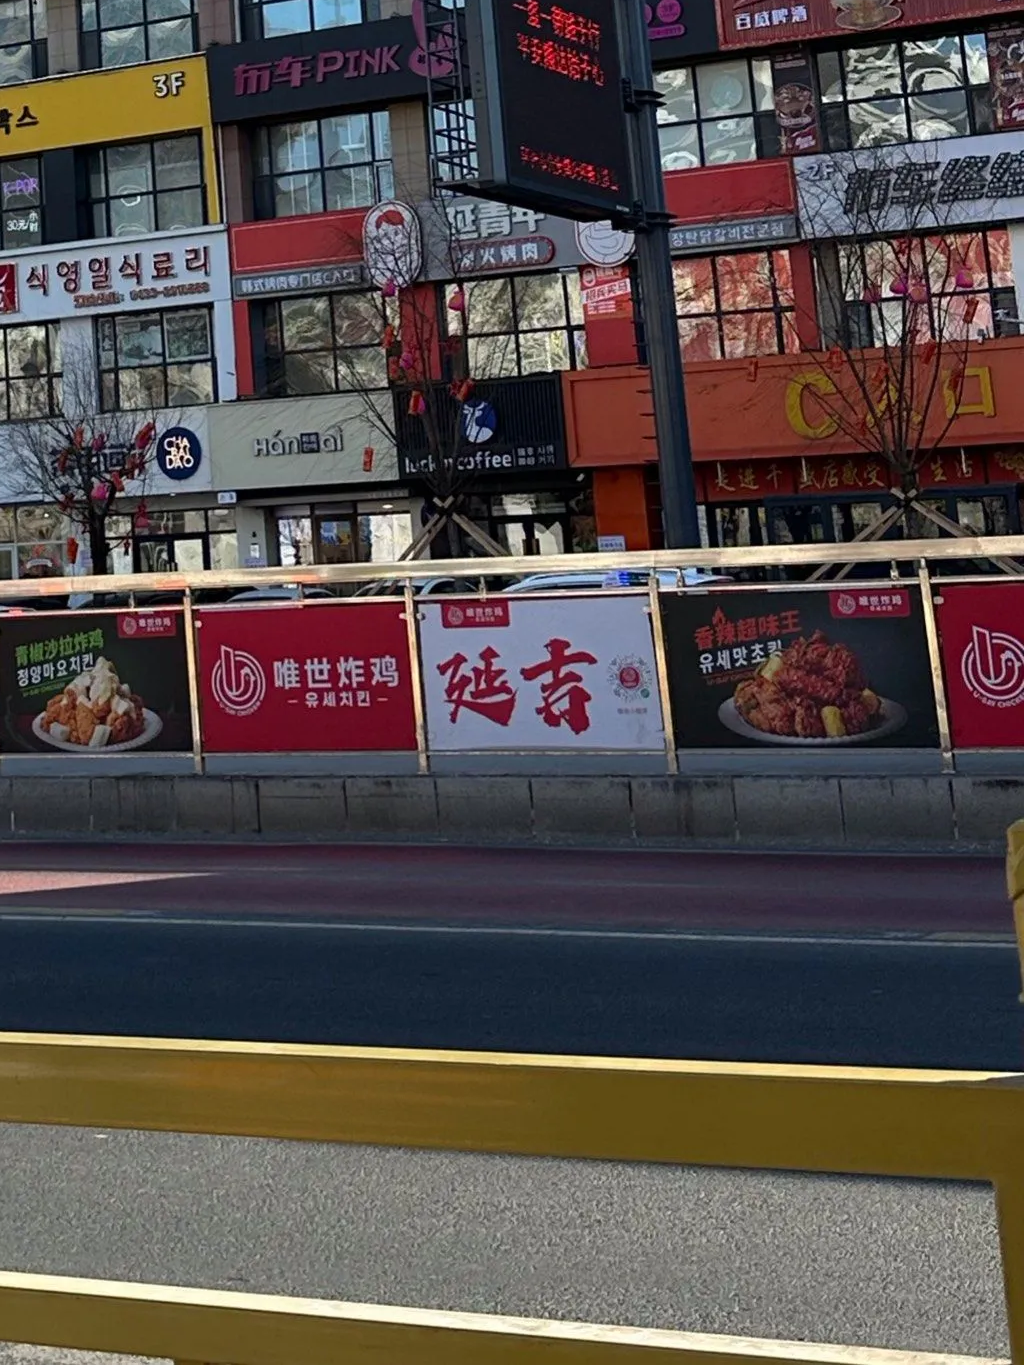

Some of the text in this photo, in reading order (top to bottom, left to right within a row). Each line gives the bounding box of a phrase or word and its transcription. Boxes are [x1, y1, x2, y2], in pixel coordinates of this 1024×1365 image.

[735, 5, 808, 31] 百威啤酒
[152, 69, 186, 99] 3F
[26, 245, 212, 297] 식영일식료리
[164, 436, 190, 452] CHA
[165, 453, 194, 470] DAO
[15, 628, 104, 666] 青椒沙拉炸鸡
[694, 609, 803, 651] 香辣超味王
[17, 651, 95, 687] 청양마요치킨
[273, 654, 401, 690] 唯世炸鸡
[436, 637, 598, 736] 延吉
[304, 690, 372, 709] 유세치킨
